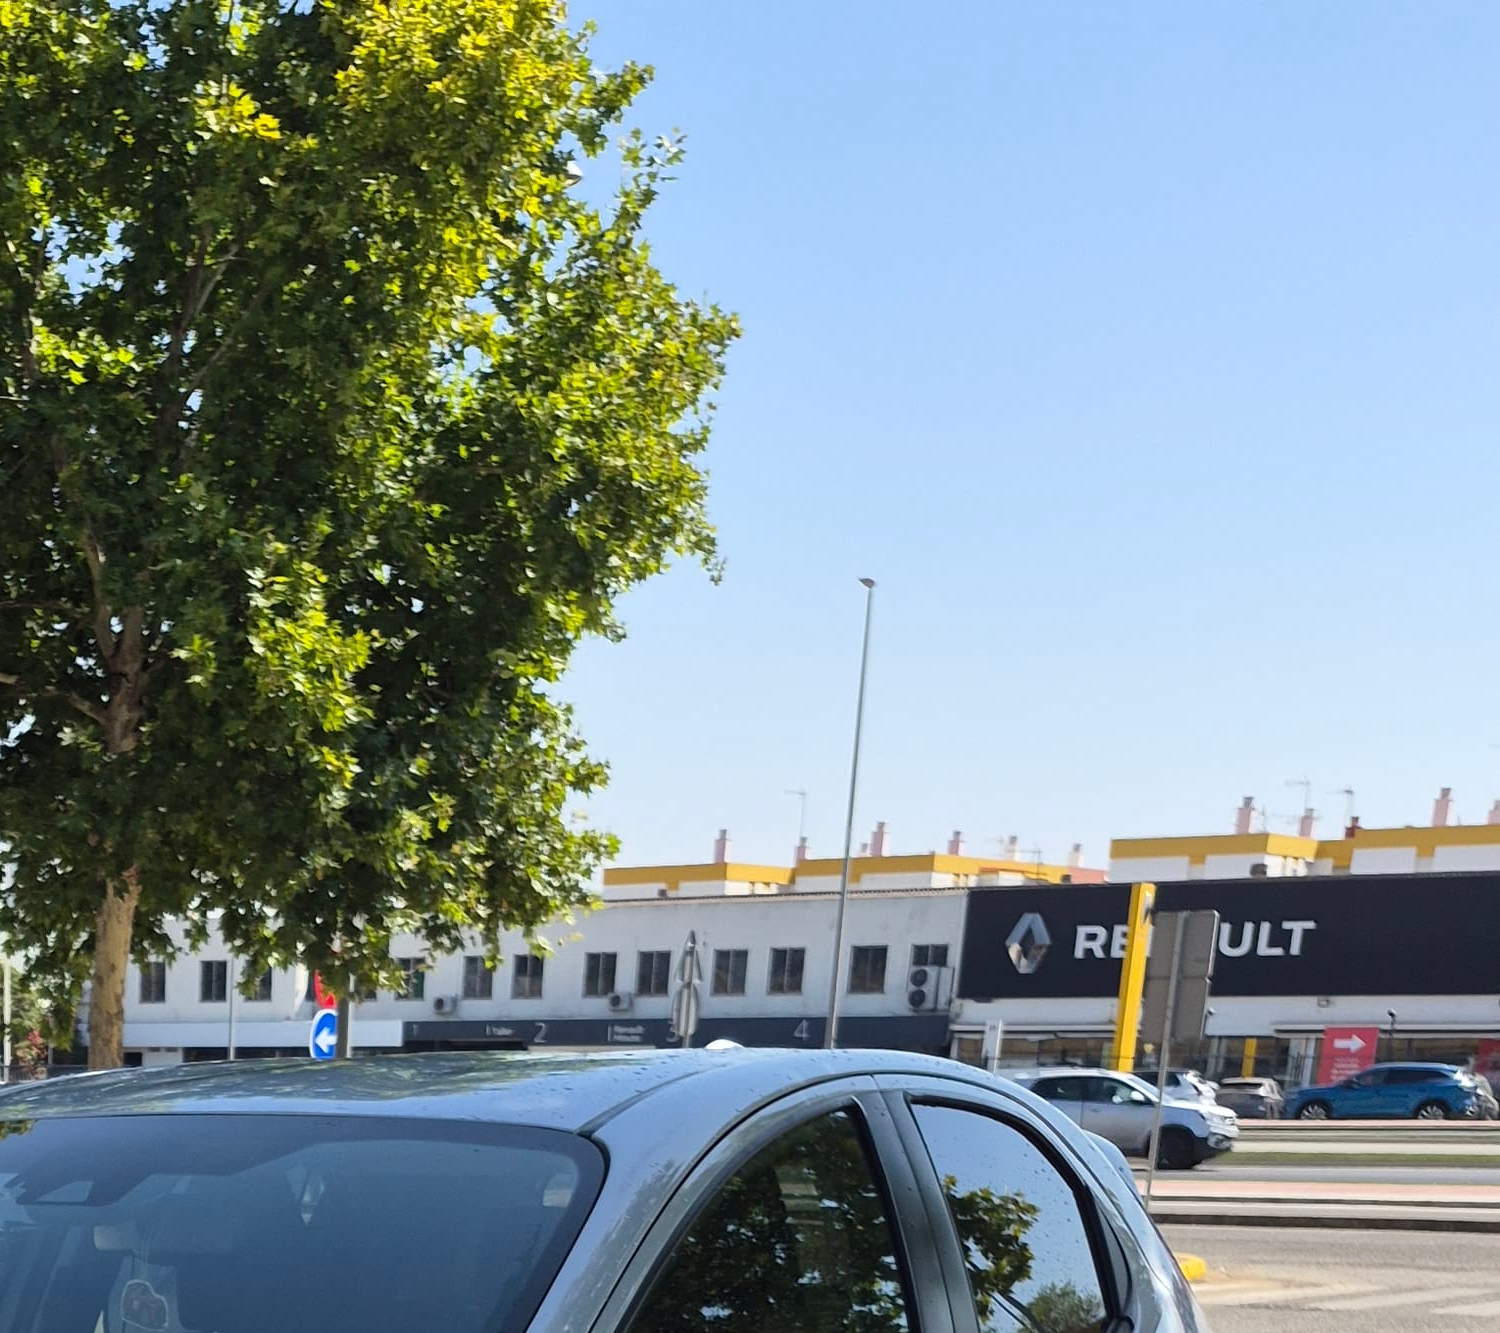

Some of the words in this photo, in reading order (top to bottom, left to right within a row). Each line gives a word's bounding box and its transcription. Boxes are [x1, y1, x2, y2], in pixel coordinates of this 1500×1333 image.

[1074, 921, 1317, 960] REULT
[533, 1022, 548, 1042] 2
[794, 1019, 810, 1041] 4
